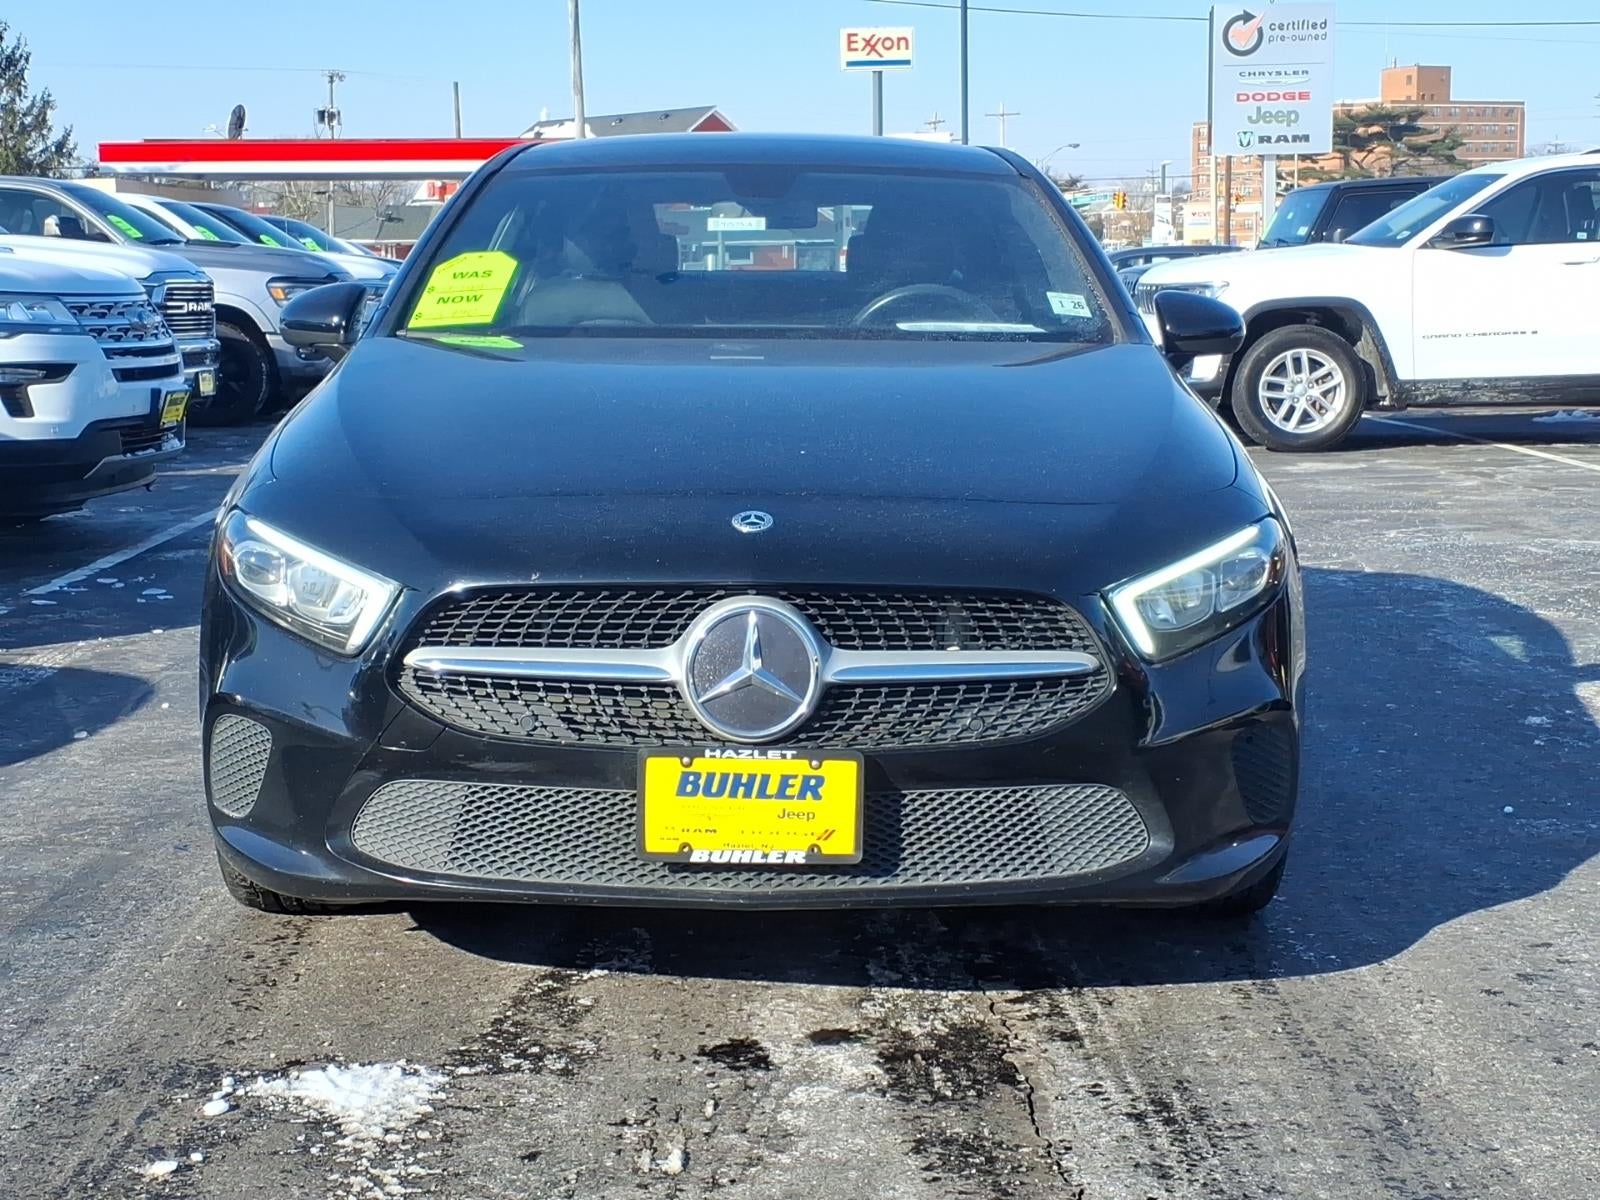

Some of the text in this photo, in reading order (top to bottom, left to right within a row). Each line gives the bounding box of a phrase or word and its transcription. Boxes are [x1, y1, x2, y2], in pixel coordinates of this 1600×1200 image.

[1268, 18, 1327, 32] certified
[1268, 32, 1327, 44] pre-owned
[846, 33, 909, 58] Exxon
[1238, 69, 1310, 78] CHRYSLER
[1236, 91, 1311, 103] DODGE
[1247, 106, 1300, 127] Jeep
[1257, 133, 1311, 145] RAM
[453, 270, 493, 280] WAS
[436, 294, 484, 305] NOW
[188, 302, 211, 311] RAM
[704, 748, 798, 760] HAZLET
[676, 770, 826, 801] BUHLER
[777, 808, 817, 822] Jeep
[689, 849, 807, 864] BUHLER
